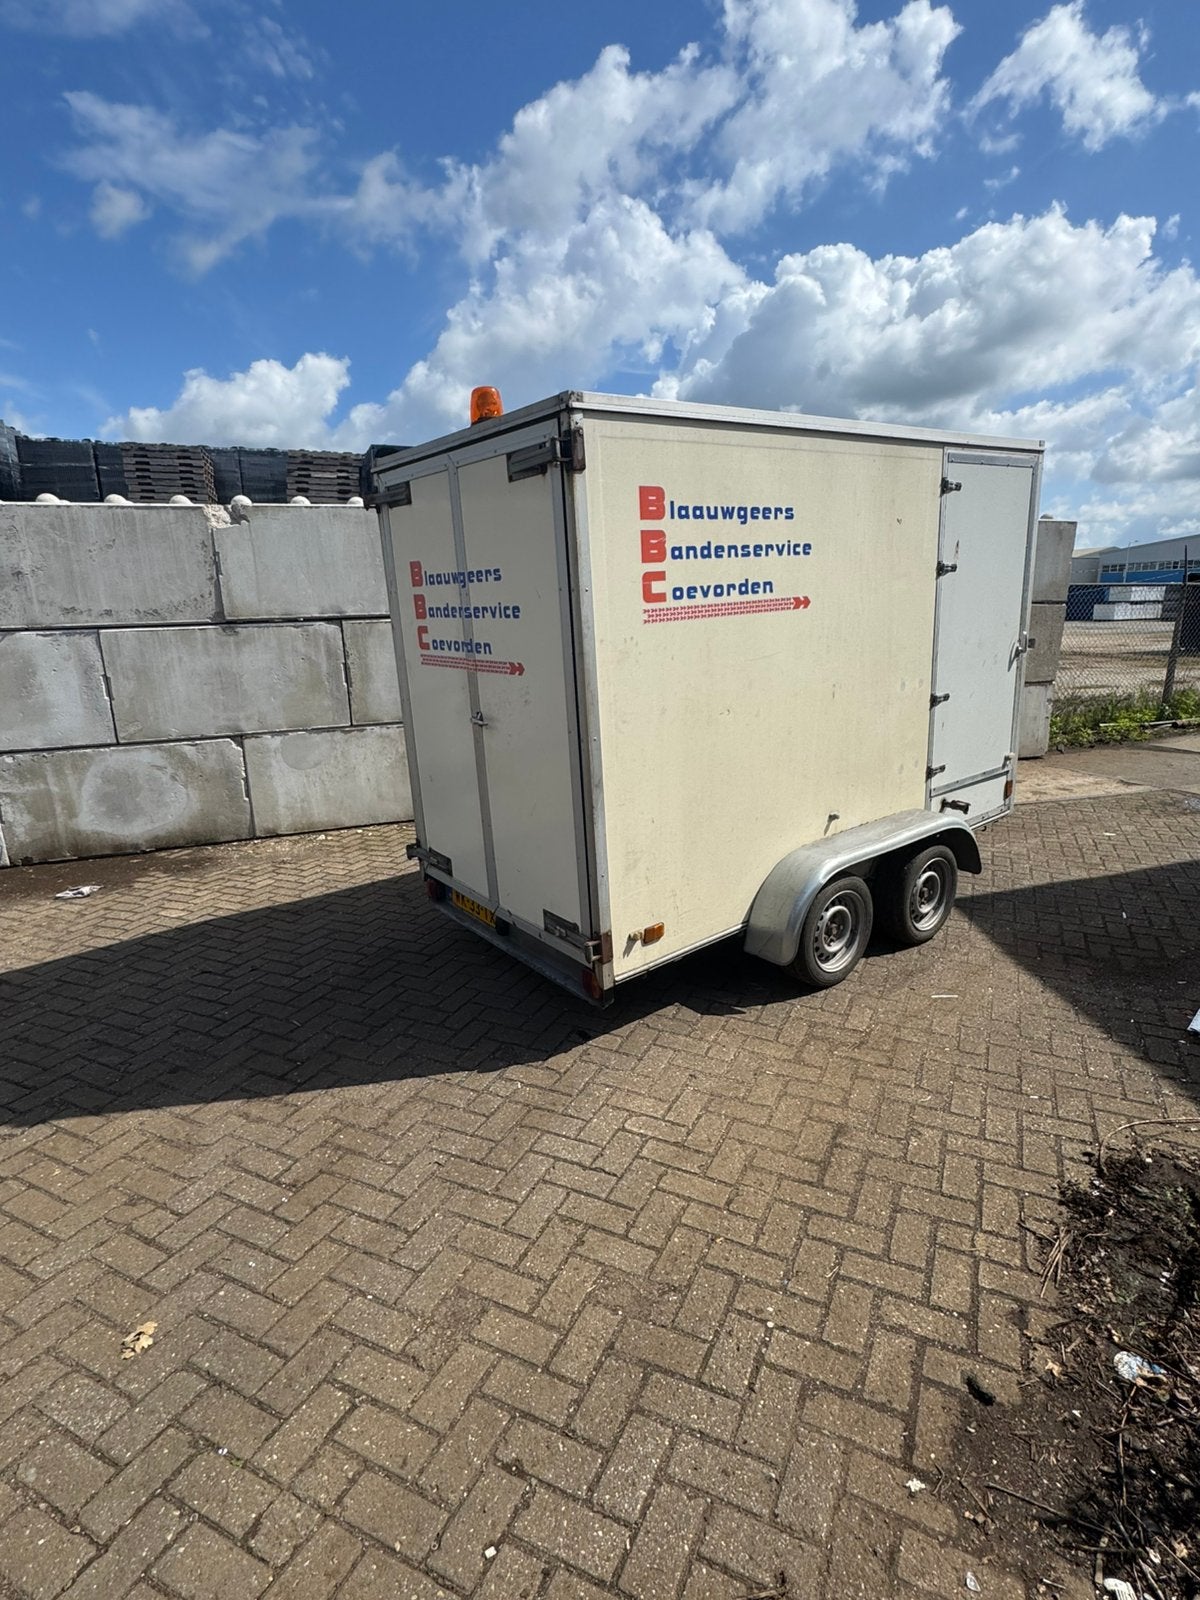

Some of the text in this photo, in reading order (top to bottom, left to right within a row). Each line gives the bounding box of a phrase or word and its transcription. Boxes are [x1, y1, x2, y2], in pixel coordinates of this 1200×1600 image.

[638, 485, 795, 525] Blaauwgeers
[640, 529, 812, 564] Bandenservice
[409, 560, 502, 588] Blaauwgeers
[641, 570, 774, 604] Coevorden
[417, 625, 493, 655] Coevorden
